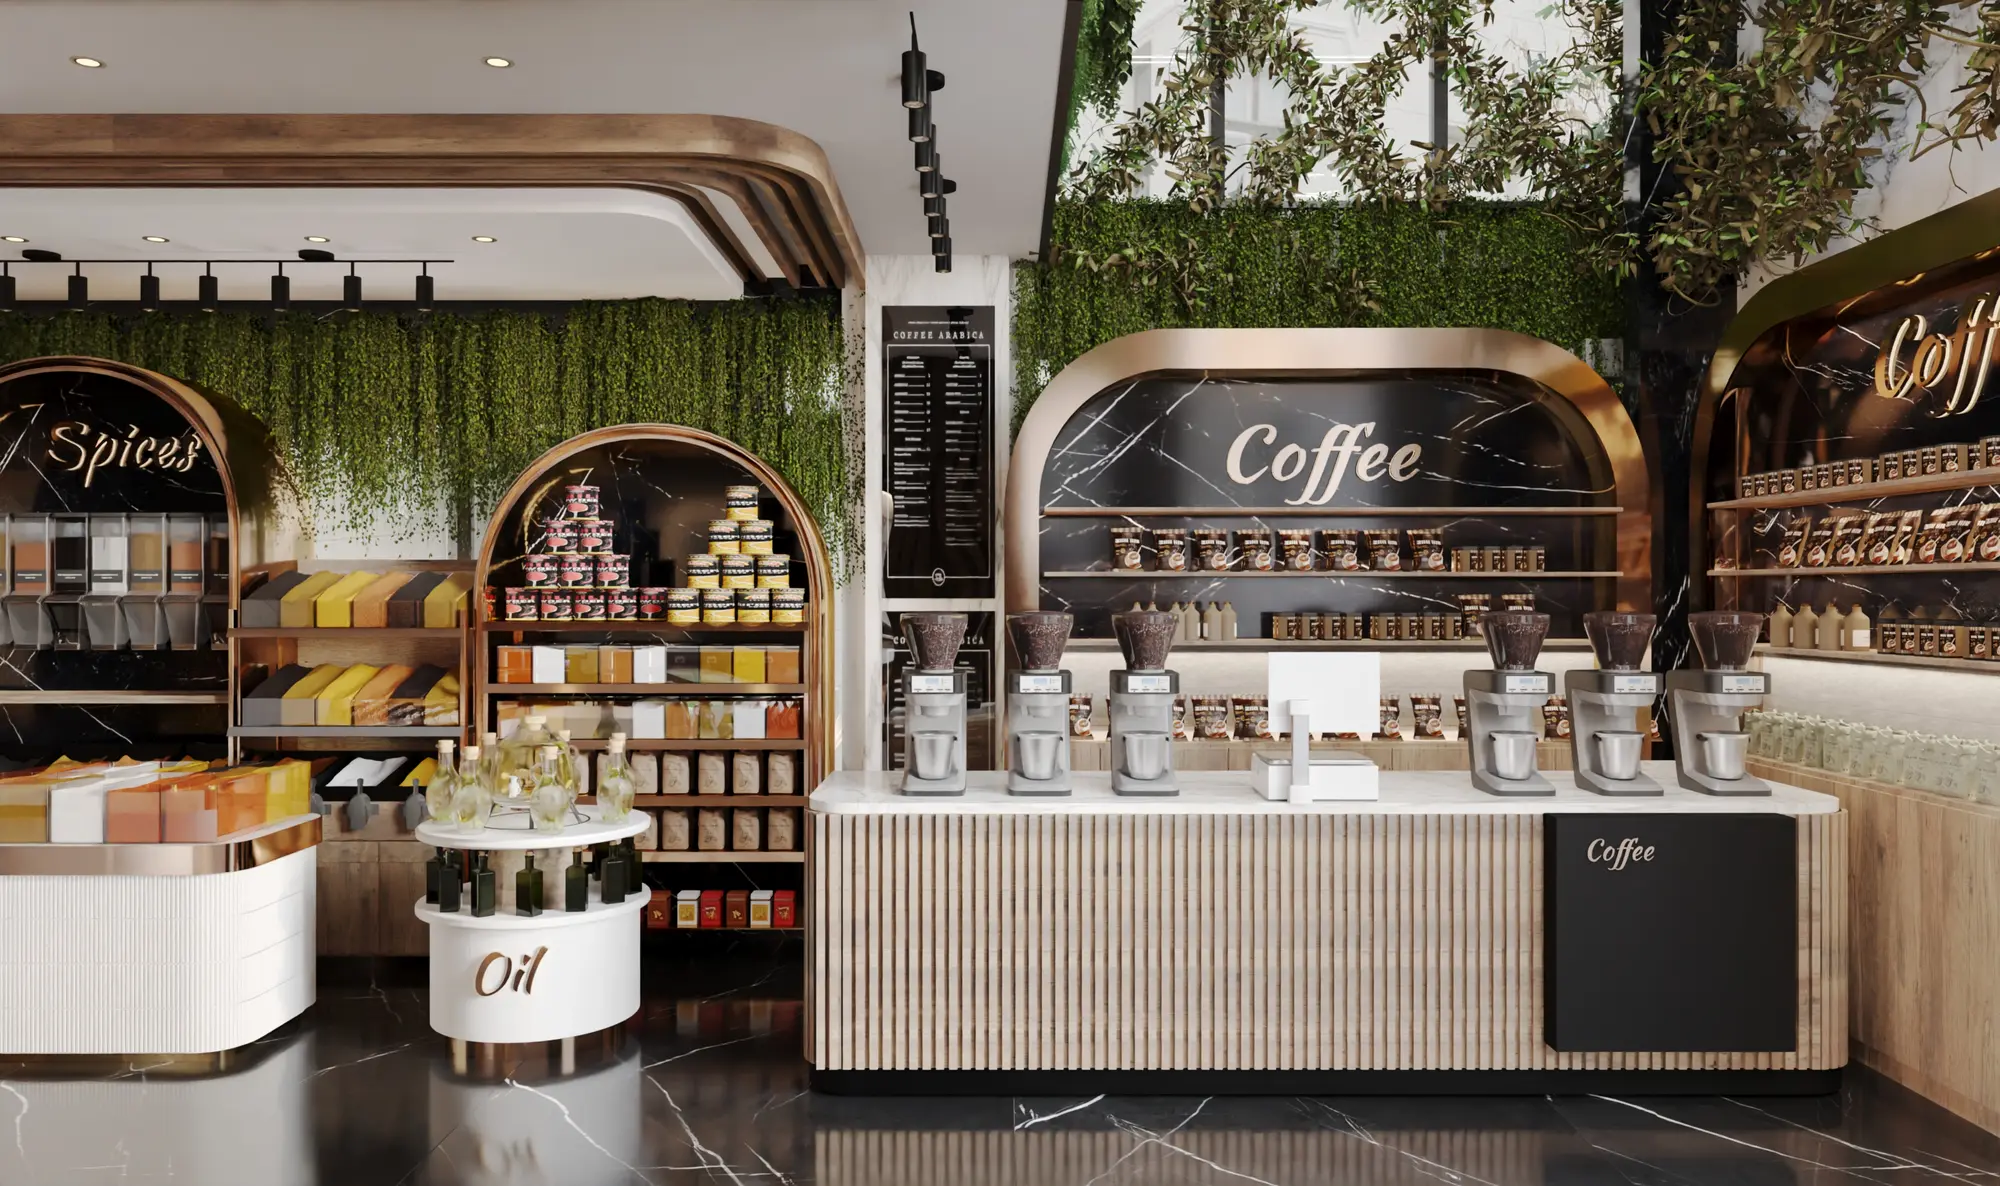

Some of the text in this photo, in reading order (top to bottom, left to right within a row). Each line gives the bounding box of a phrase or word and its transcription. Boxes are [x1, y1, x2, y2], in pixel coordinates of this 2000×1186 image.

[893, 331, 984, 340] COFFEE ARABICA
[48, 421, 203, 488] Spices
[1226, 421, 1422, 505] Coffee
[1586, 837, 1656, 871] Coffee
[475, 945, 549, 997] Oil
